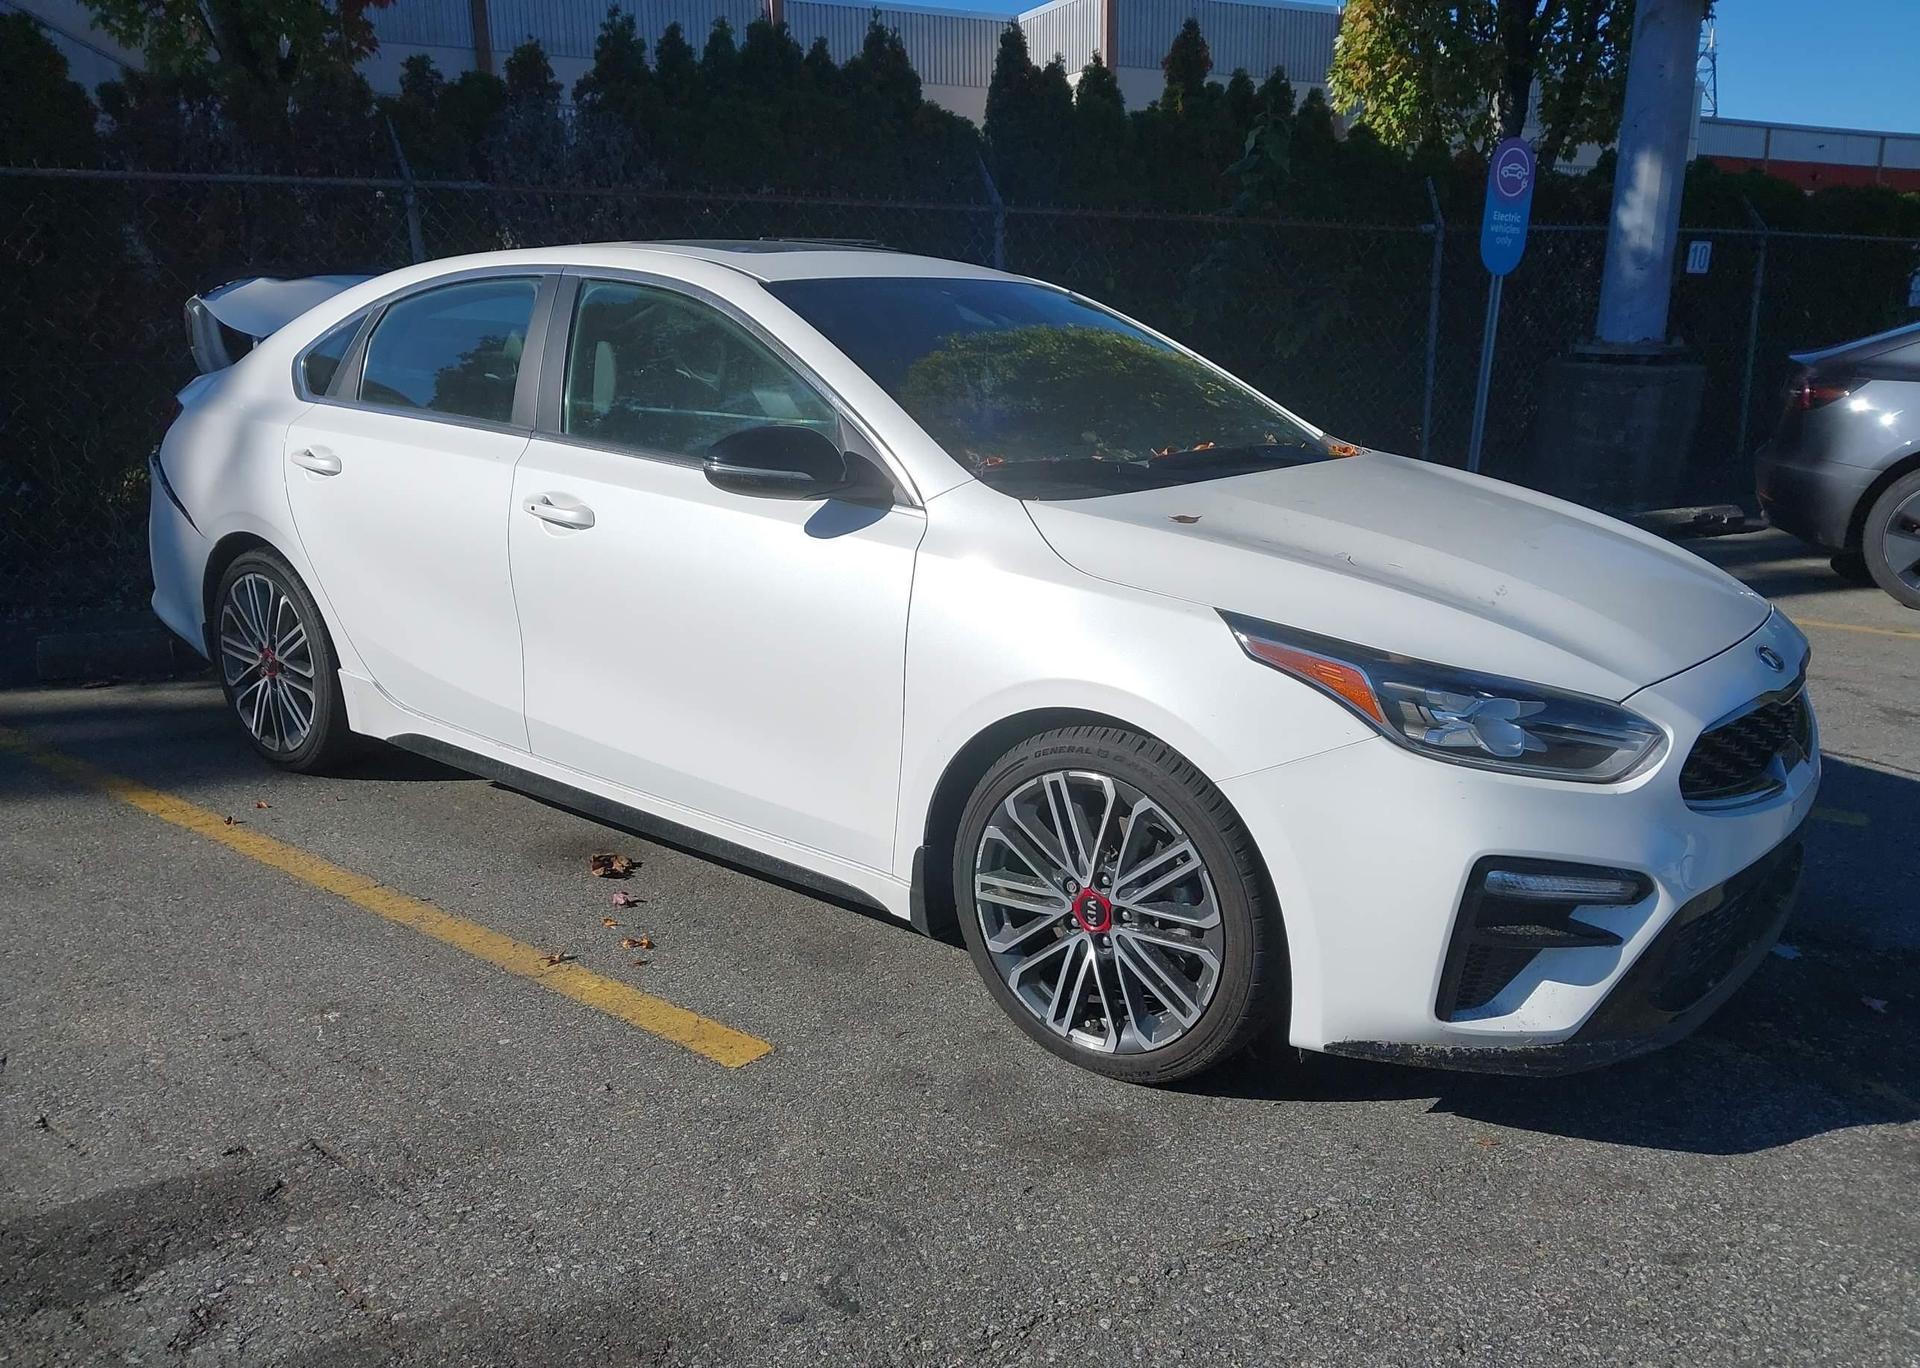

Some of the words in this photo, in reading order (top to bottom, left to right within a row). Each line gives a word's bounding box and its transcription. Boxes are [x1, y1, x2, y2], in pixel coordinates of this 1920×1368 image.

[1493, 210, 1521, 223] Electric
[1490, 223, 1520, 234] vehicles
[1496, 236, 1512, 247] only
[1691, 245, 1709, 269] 10
[1034, 745, 1093, 759] GENERAL
[1087, 900, 1097, 926] KIA
